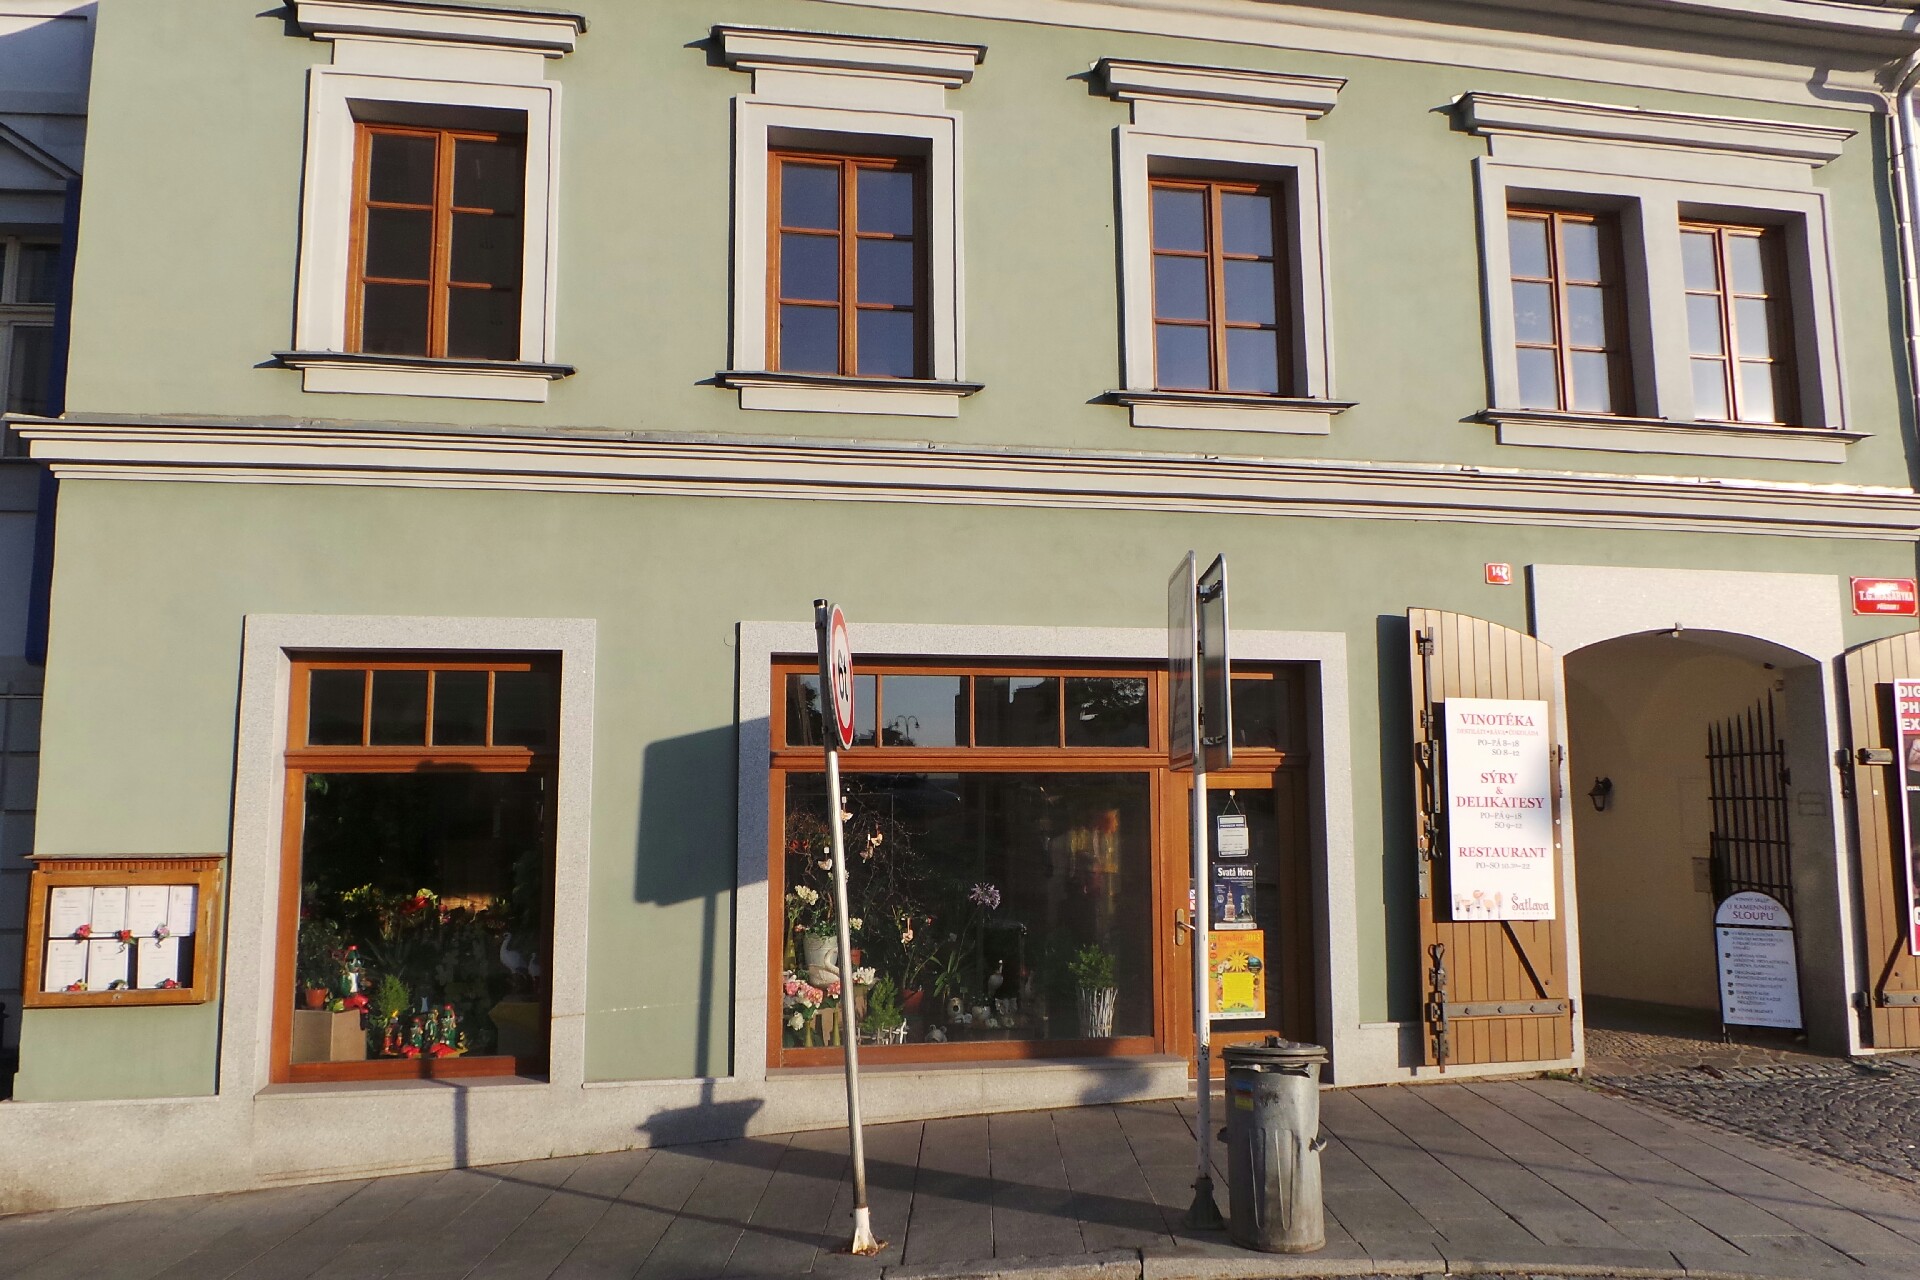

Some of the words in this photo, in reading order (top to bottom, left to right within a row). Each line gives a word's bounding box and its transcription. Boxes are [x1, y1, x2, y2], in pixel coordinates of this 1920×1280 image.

[1460, 712, 1535, 727] VINOTÉKA
[1480, 770, 1518, 784] SÝRY
[1495, 786, 1504, 795] &
[1456, 796, 1545, 808] DELIKATESY
[1458, 846, 1547, 858] RESTAURANT
[1217, 867, 1237, 877] Svatá
[1237, 867, 1253, 876] Hora
[1511, 893, 1550, 911] Šatlava
[1732, 911, 1774, 921] SLOUPU
